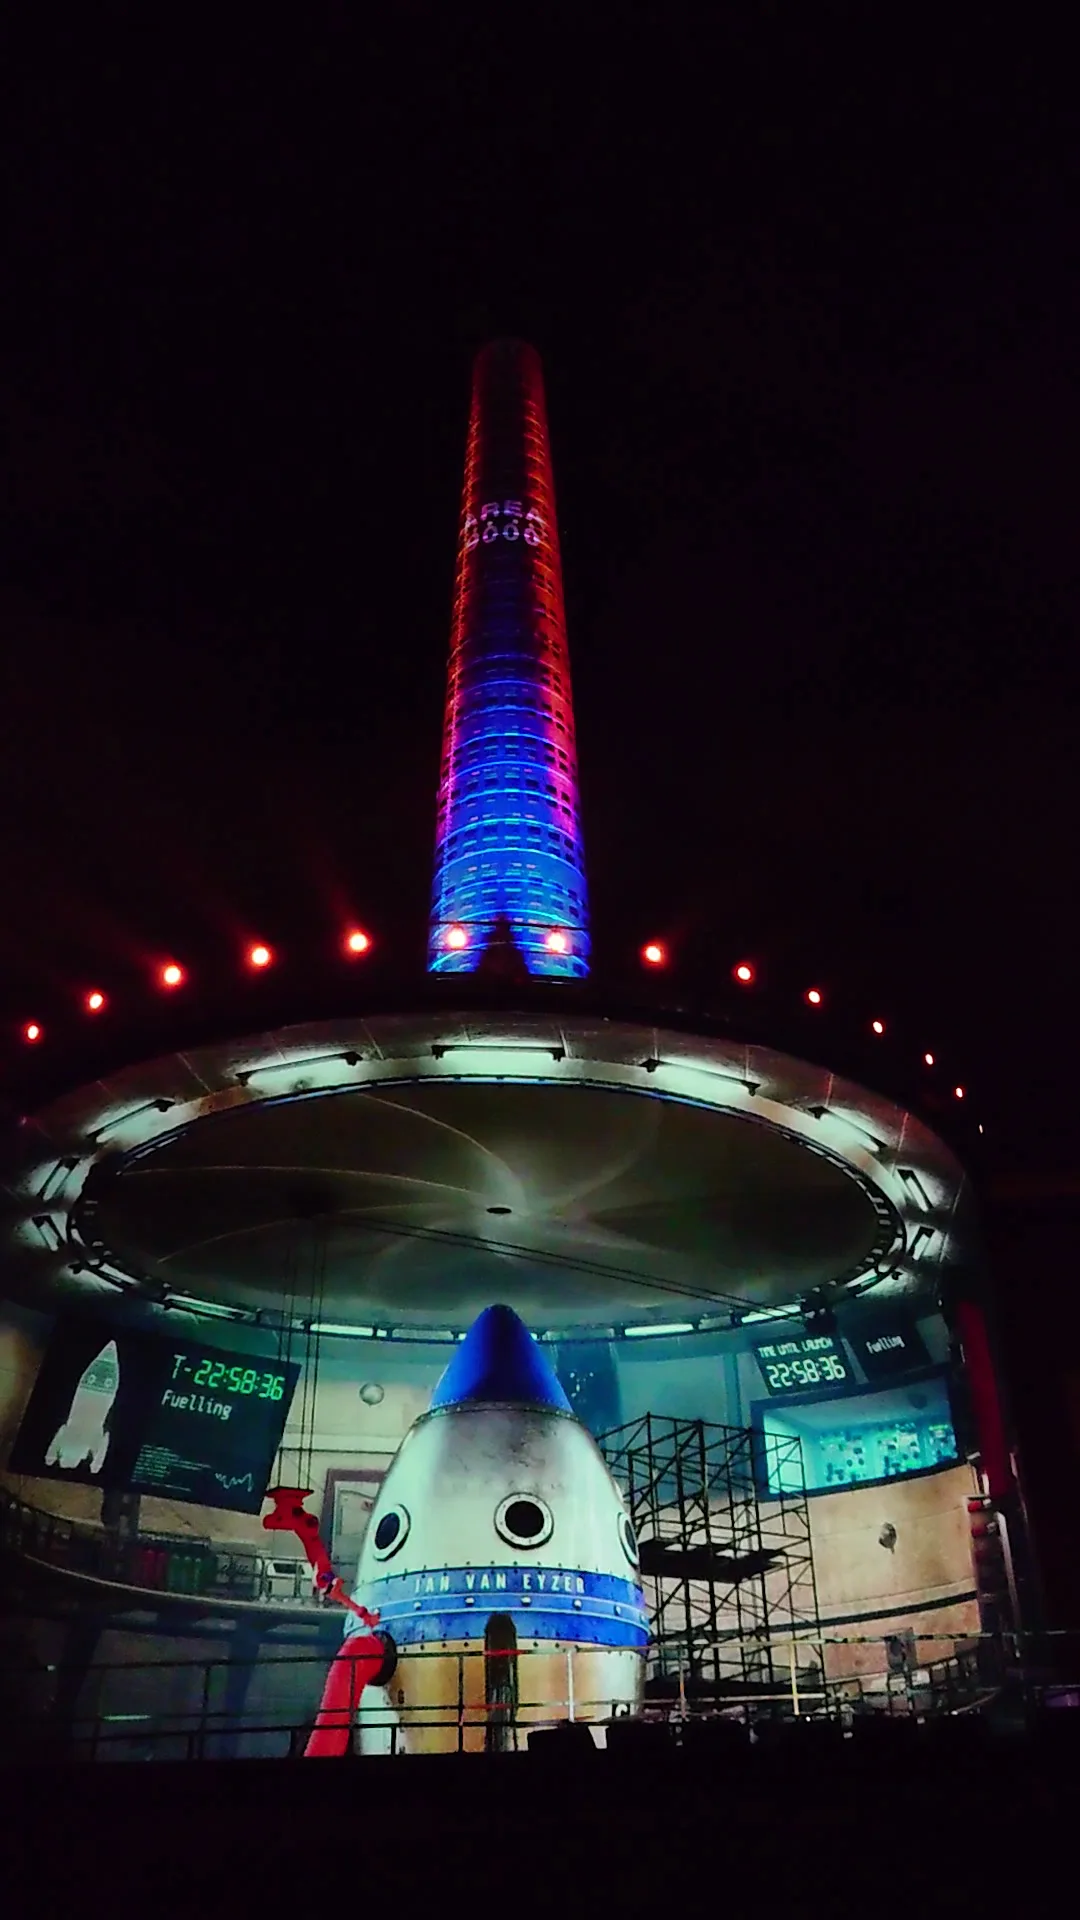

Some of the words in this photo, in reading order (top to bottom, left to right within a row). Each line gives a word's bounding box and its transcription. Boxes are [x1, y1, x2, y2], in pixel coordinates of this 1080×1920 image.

[766, 1355, 846, 1388] 22:58:36
[161, 1389, 233, 1420] Fuelling
[415, 1575, 449, 1594] JAN
[466, 1574, 507, 1591] VAN
[523, 1574, 586, 1594] EYZER
